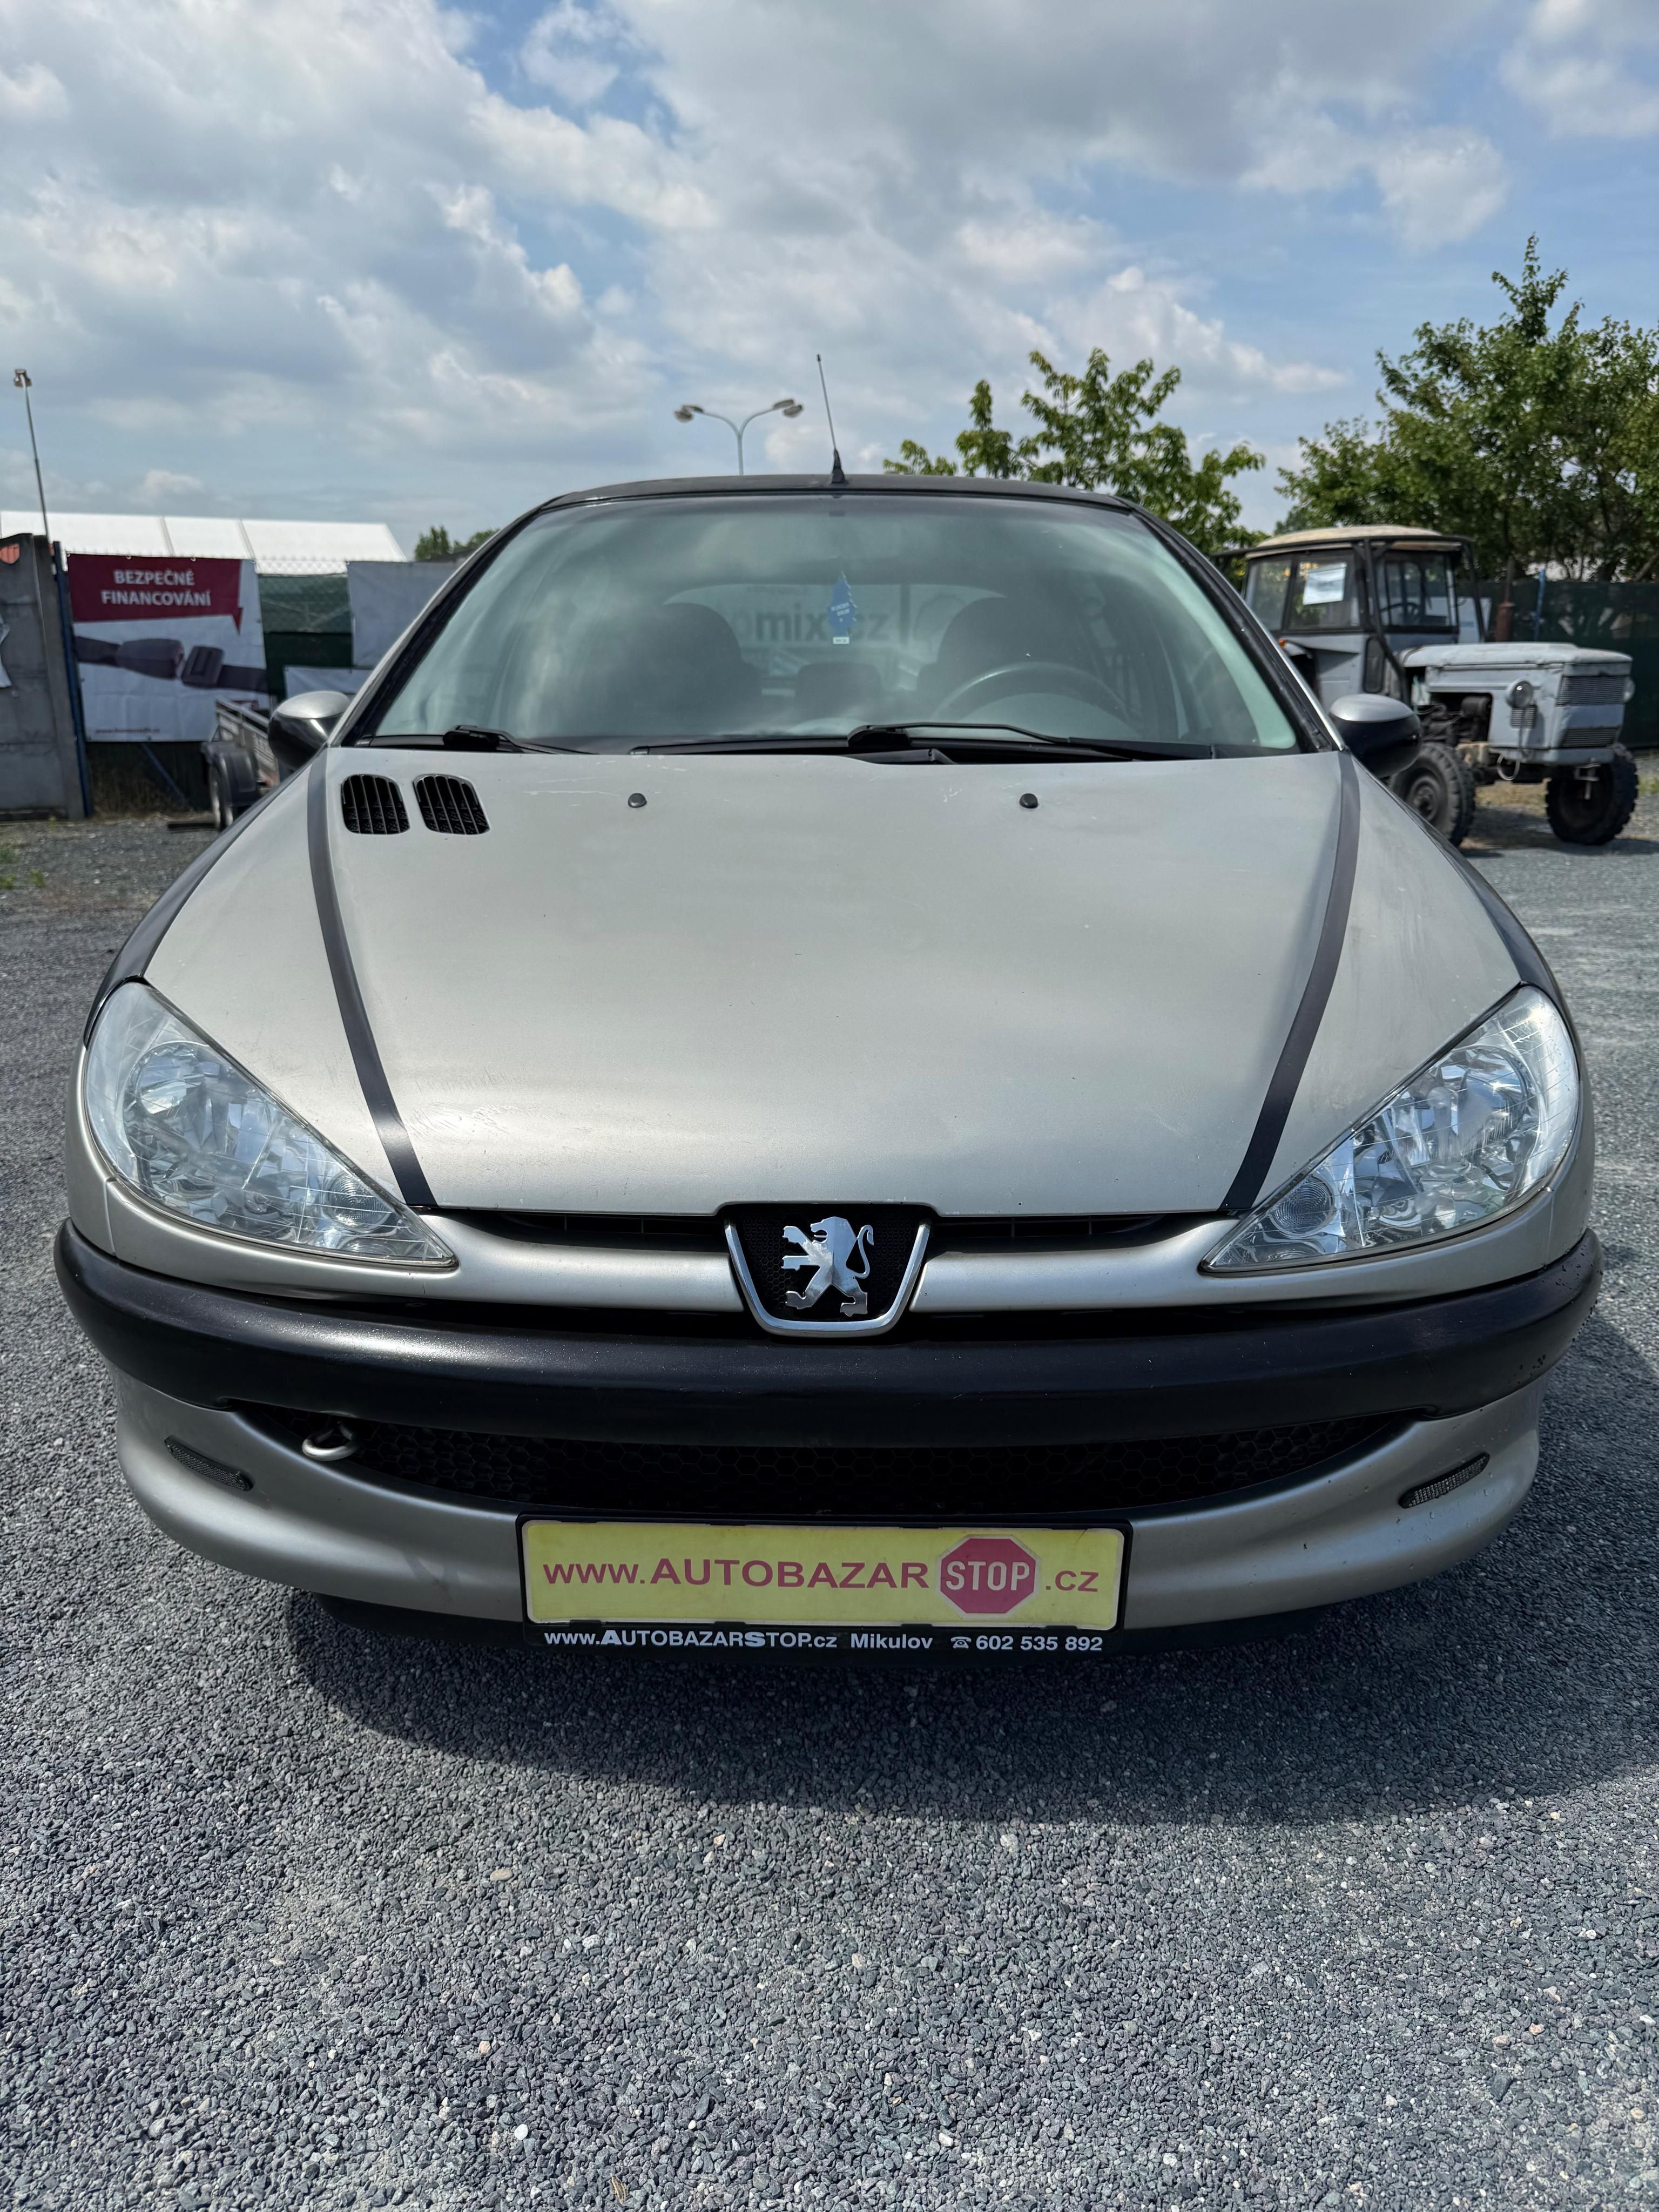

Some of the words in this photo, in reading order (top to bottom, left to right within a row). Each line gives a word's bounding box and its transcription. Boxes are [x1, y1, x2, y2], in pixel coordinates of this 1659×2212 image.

[113, 568, 195, 585] BEZPEČNÉ
[100, 589, 211, 606] FINANCOVÁNÍ
[946, 1561, 1030, 1591] STOP
[851, 1633, 933, 1649] Mikulov
[976, 1635, 1013, 1650] 602
[1020, 1636, 1058, 1650] 535
[1065, 1636, 1103, 1651] 892
